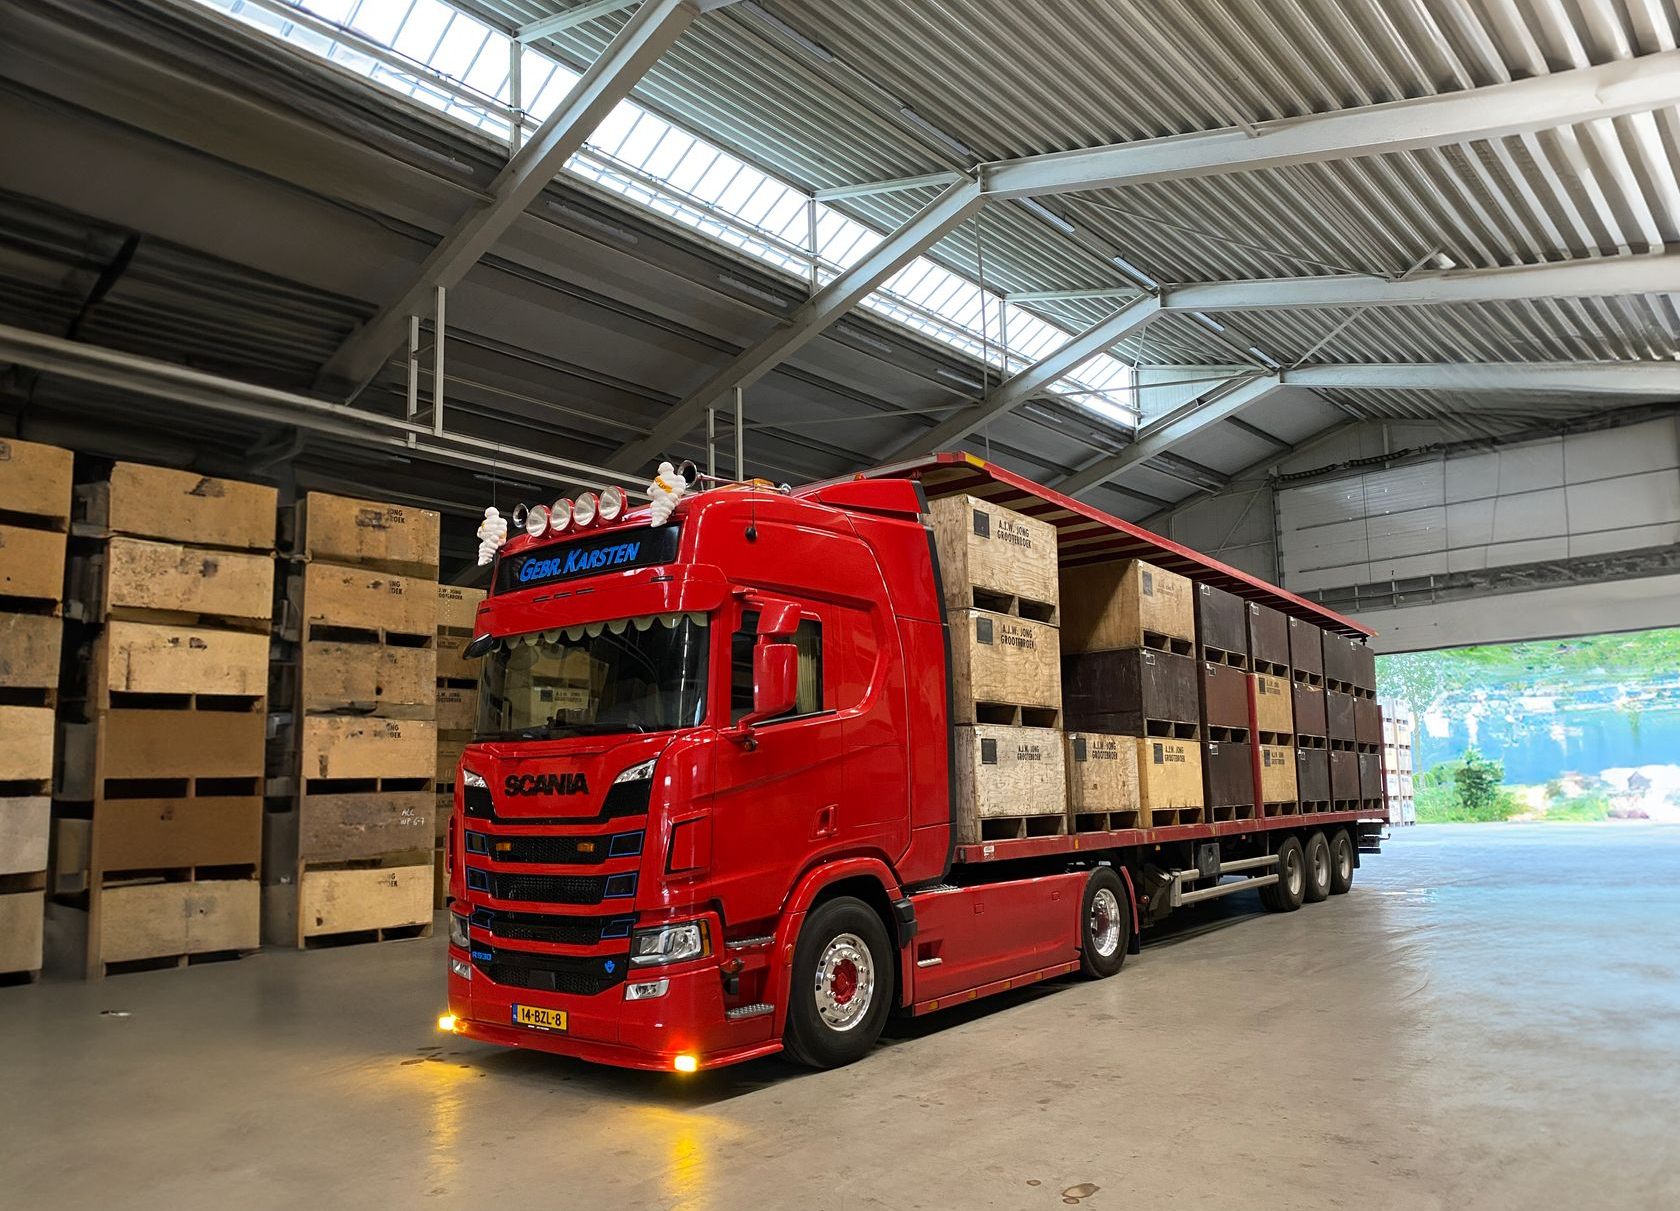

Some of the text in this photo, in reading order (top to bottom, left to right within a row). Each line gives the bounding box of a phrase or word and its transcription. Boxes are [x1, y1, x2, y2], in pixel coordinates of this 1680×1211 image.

[1016, 525, 1030, 538] JONG
[520, 542, 640, 581] GEBR. KARSTEN
[1020, 627, 1033, 639] JONG
[505, 772, 590, 797] SCANIA
[521, 1007, 562, 1027] 14-BZL-8
